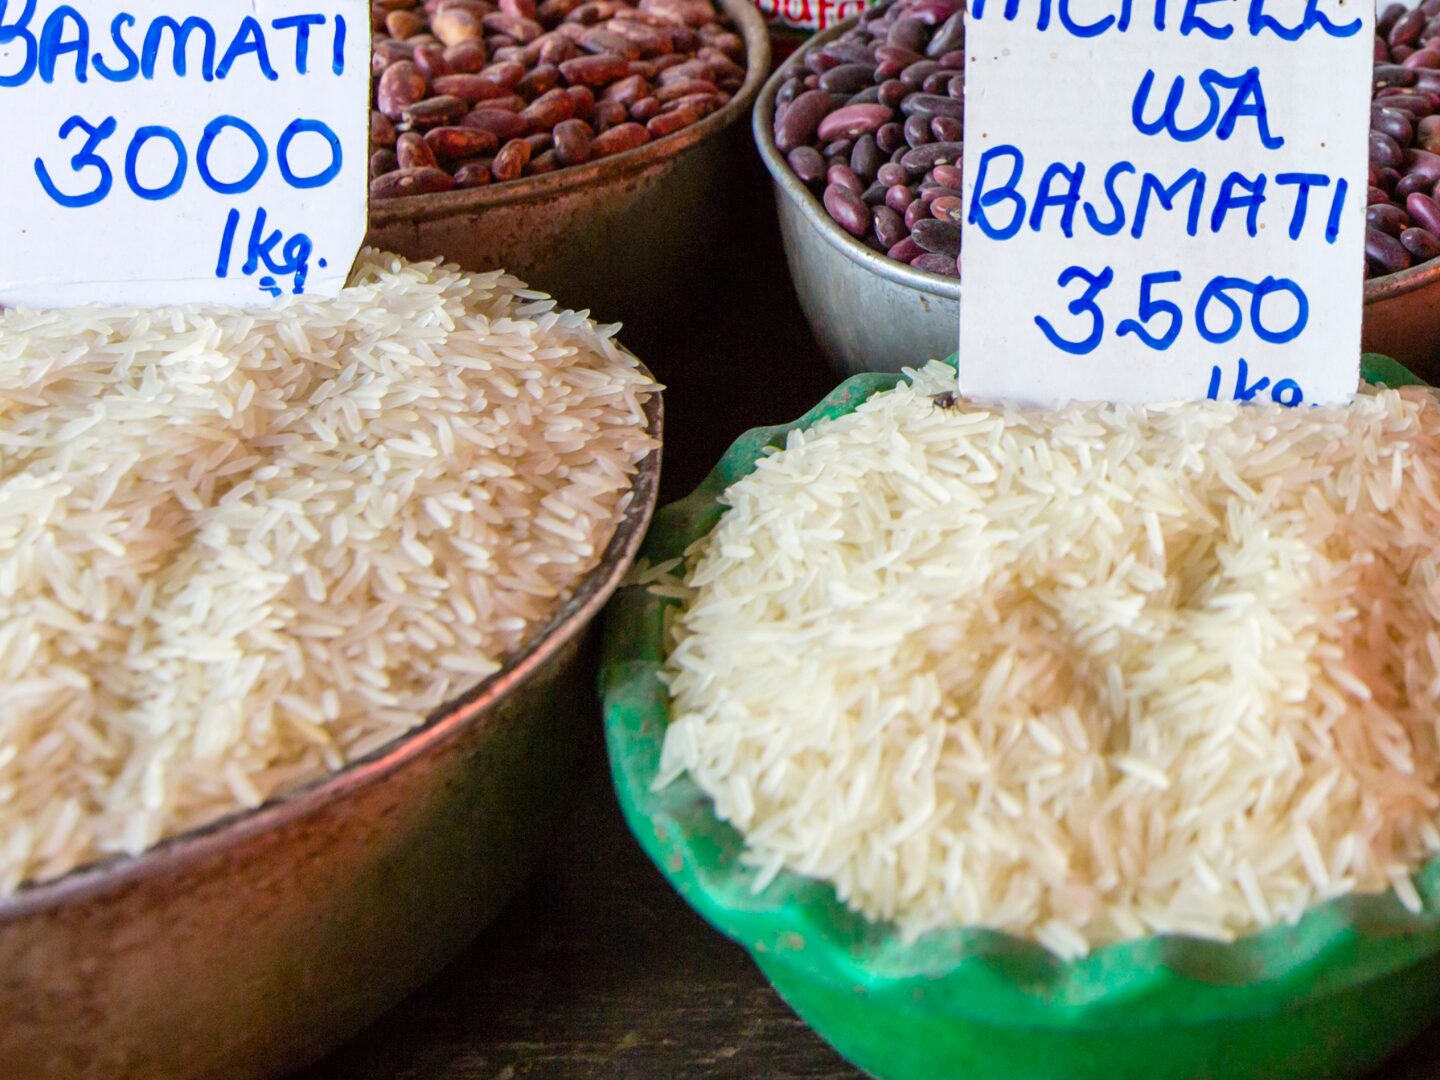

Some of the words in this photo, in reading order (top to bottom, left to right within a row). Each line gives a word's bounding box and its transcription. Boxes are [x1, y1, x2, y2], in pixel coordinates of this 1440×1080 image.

[1131, 65, 1286, 150] WA
[33, 114, 343, 209] 3000
[968, 144, 1348, 245] BASMATI
[1034, 265, 1310, 356] 3500
